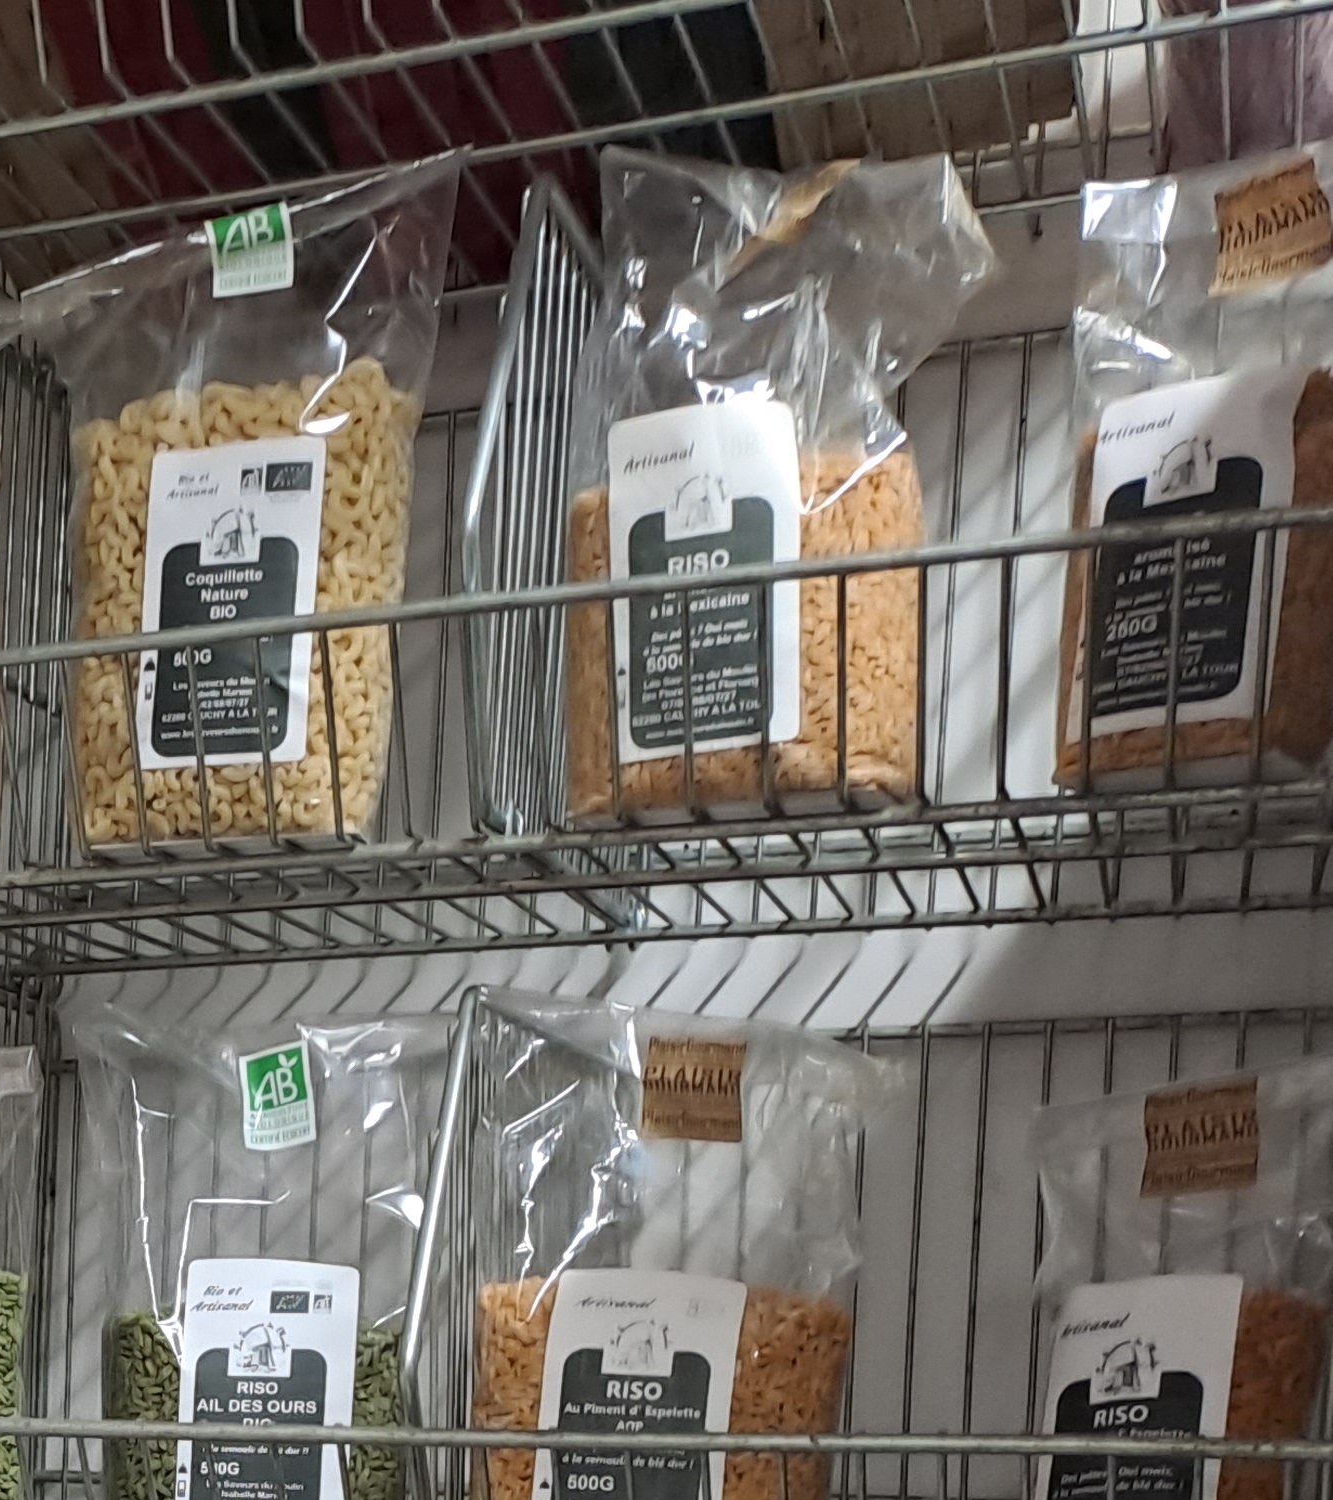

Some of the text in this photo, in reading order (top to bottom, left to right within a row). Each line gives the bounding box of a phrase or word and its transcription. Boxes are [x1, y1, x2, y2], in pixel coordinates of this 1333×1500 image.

[255, 1068, 298, 1110] AB
[237, 1381, 278, 1395] RISO
[606, 1381, 662, 1400] RISO
[197, 1399, 317, 1414] AIL DES OURS
[584, 1402, 626, 1417] Piment
[645, 1405, 701, 1420] Espelette
[1093, 1405, 1149, 1429] RISO
